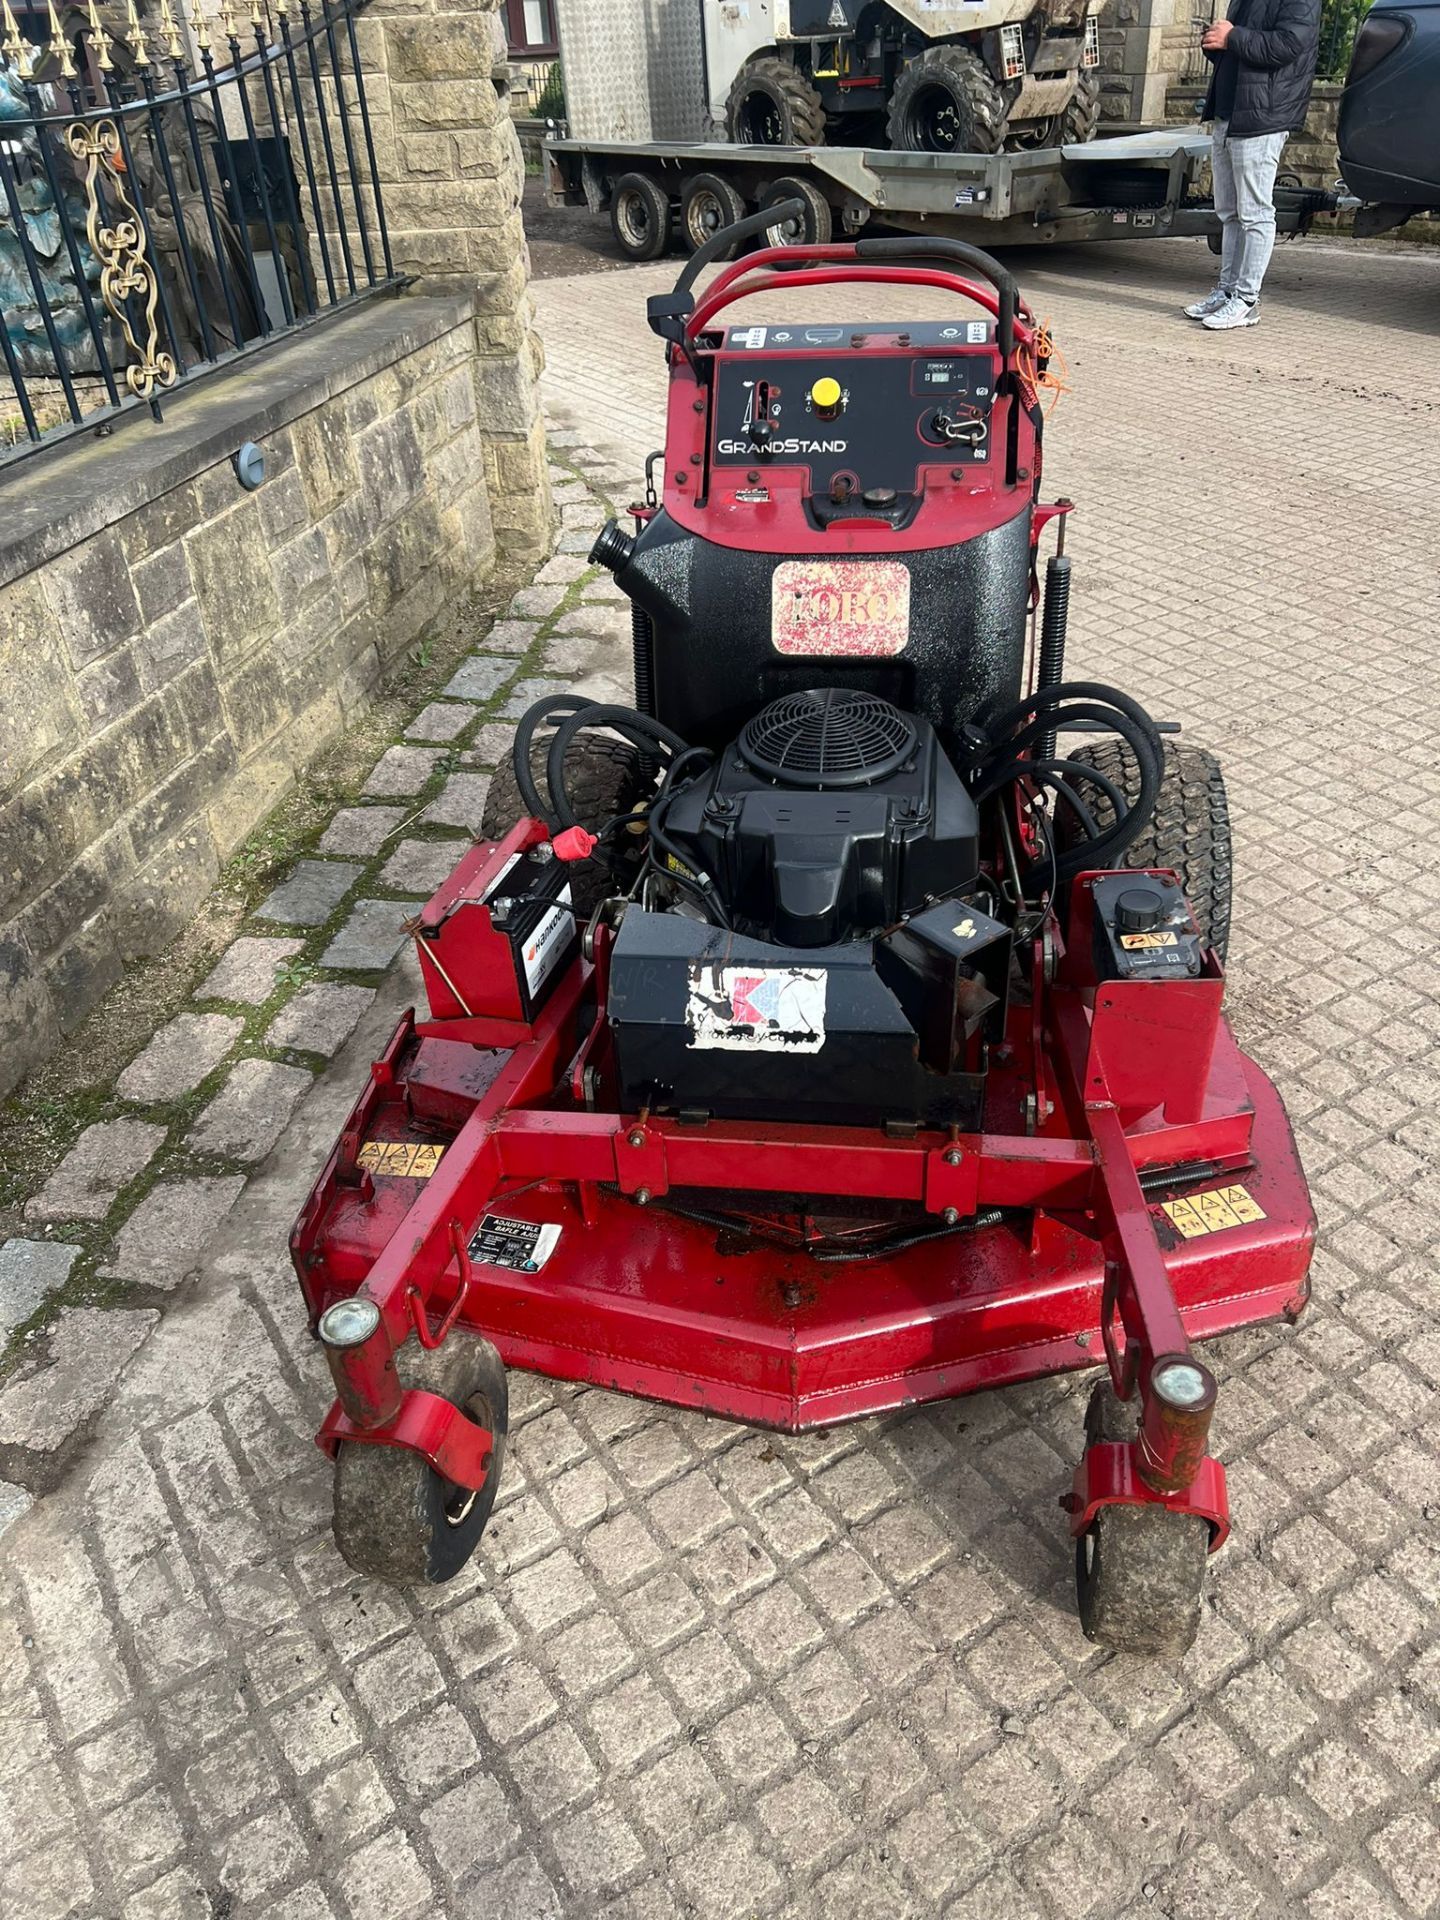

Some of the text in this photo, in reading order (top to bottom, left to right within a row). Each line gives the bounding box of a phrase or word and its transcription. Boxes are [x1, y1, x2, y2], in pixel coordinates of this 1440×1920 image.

[782, 590, 897, 625] TORO
[535, 908, 565, 953] Hankoo
[493, 1219, 540, 1233] ADJUSTABLE
[494, 1225, 520, 1235] BAFLE
